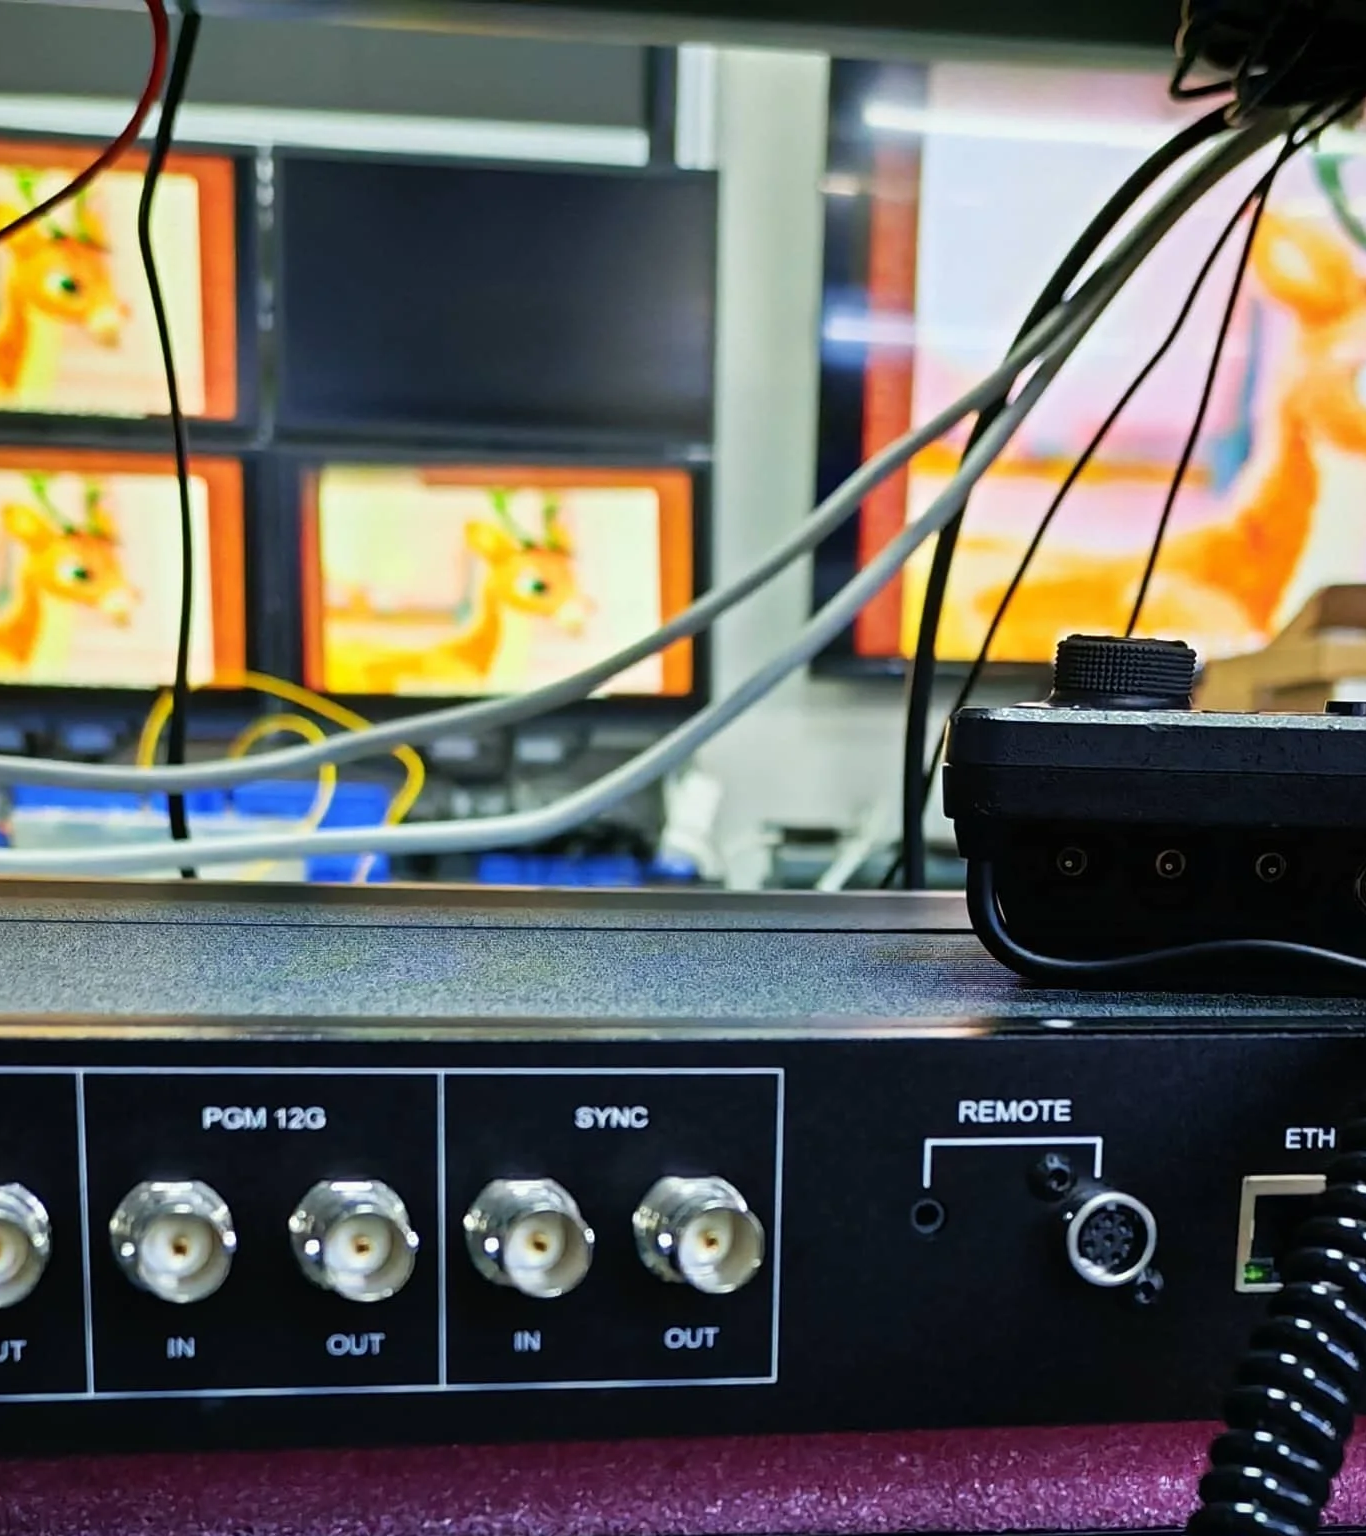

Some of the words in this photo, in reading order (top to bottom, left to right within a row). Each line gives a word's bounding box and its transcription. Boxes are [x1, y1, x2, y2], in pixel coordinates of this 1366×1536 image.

[202, 1106, 267, 1130] PGM
[274, 1106, 327, 1130] 12G
[574, 1105, 649, 1129] SYNC
[958, 1099, 1072, 1123] REMOTE
[1285, 1127, 1336, 1149] ETH
[167, 1336, 196, 1358] IN
[326, 1332, 386, 1356] OUT
[514, 1330, 541, 1351] IN
[664, 1326, 720, 1349] OUT
